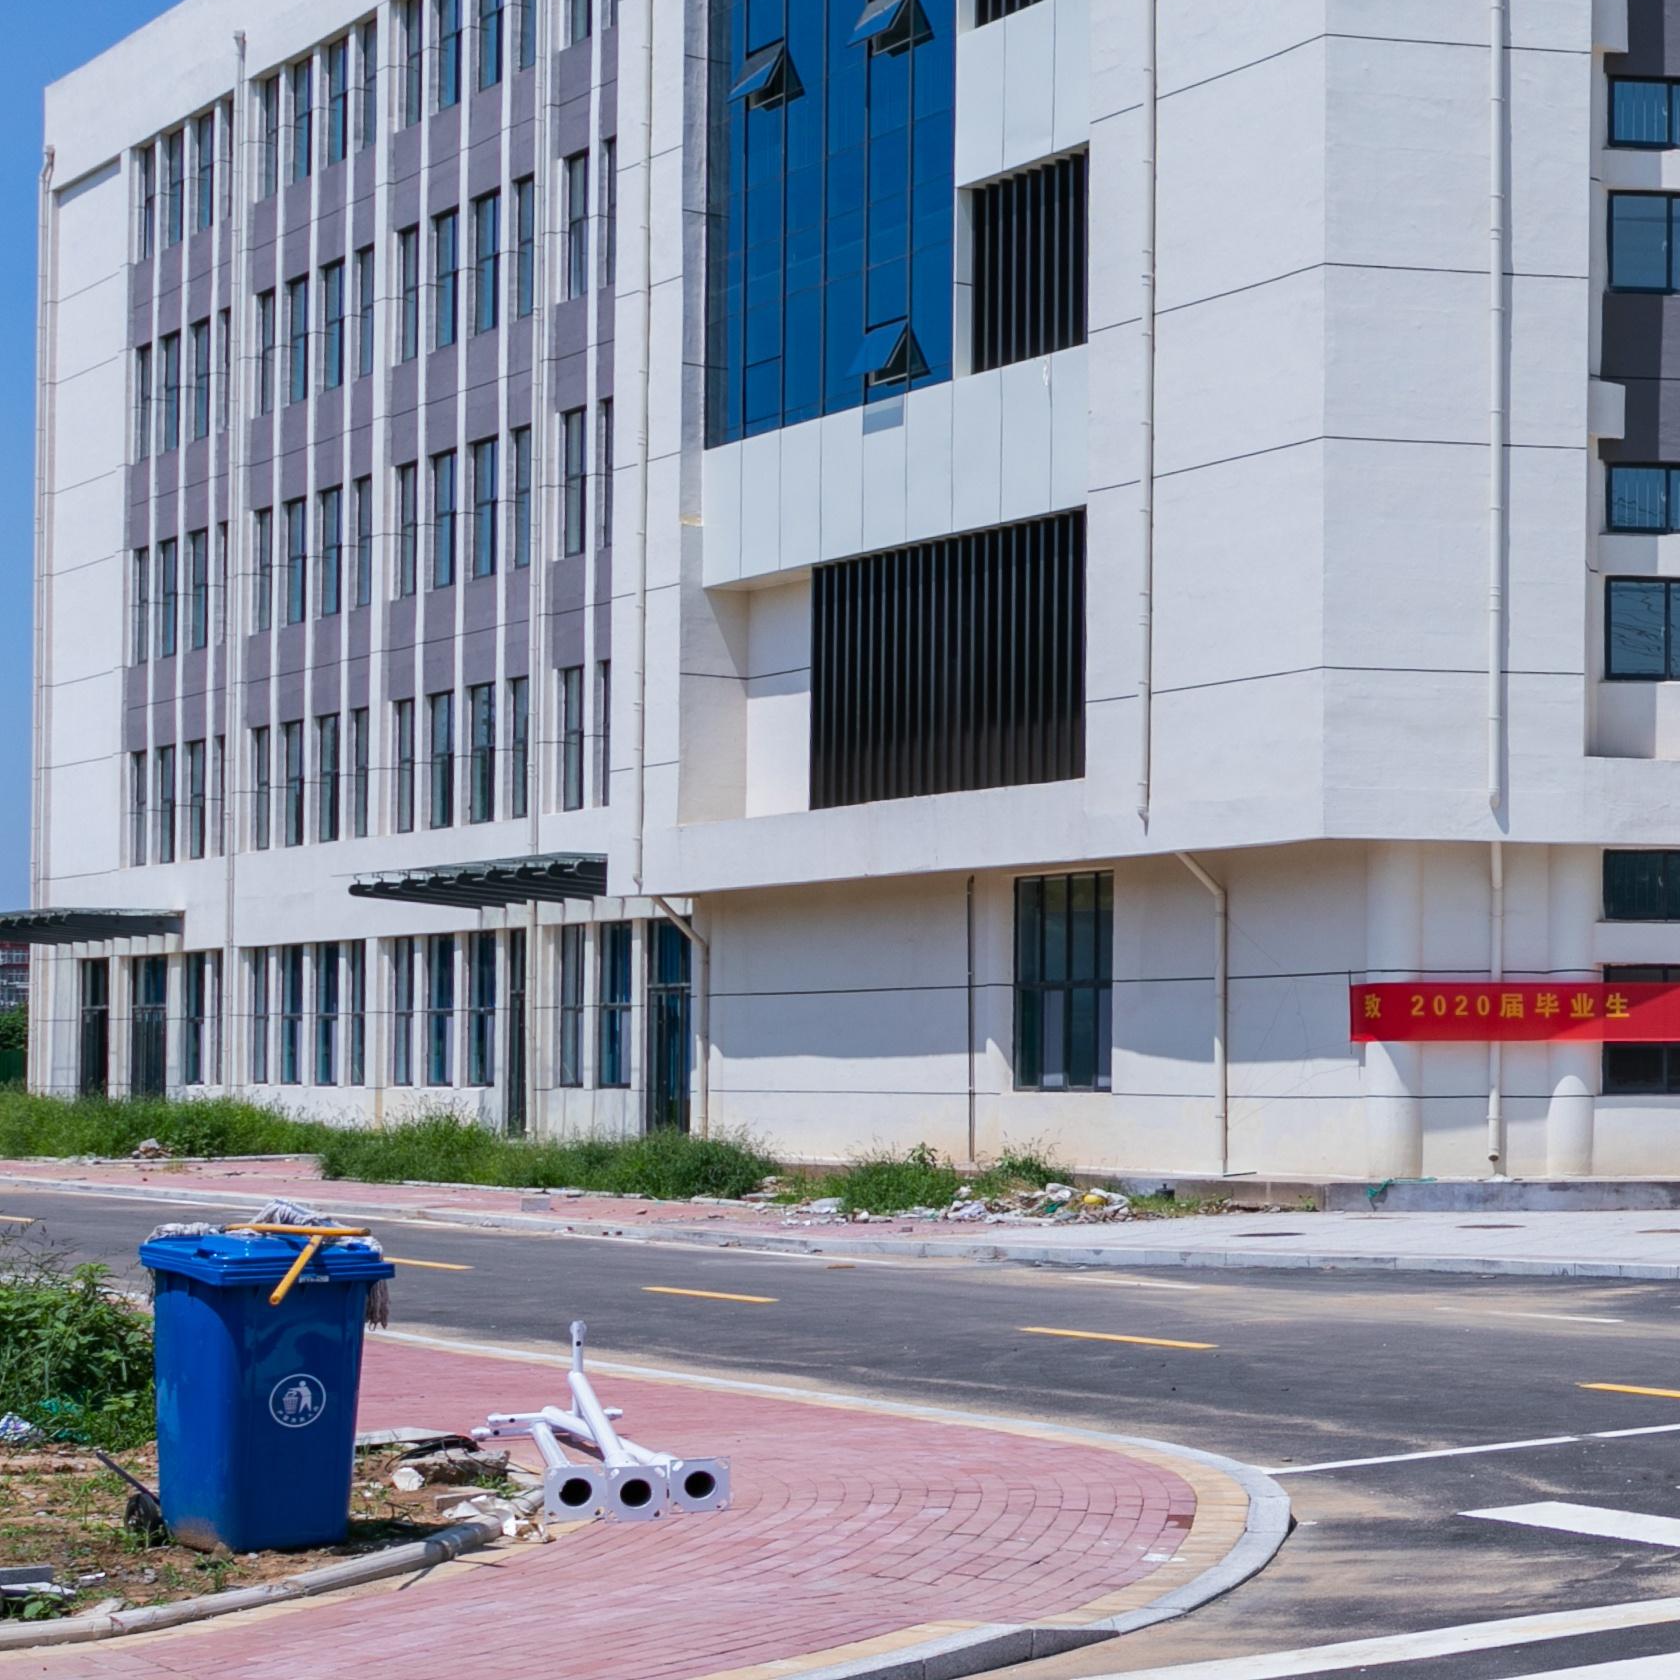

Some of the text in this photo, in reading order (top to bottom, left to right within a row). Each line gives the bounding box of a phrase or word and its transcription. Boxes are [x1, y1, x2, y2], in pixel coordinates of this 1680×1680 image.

[1364, 993, 1382, 1018] 致
[1410, 993, 1630, 1018] 2020届毕业生
